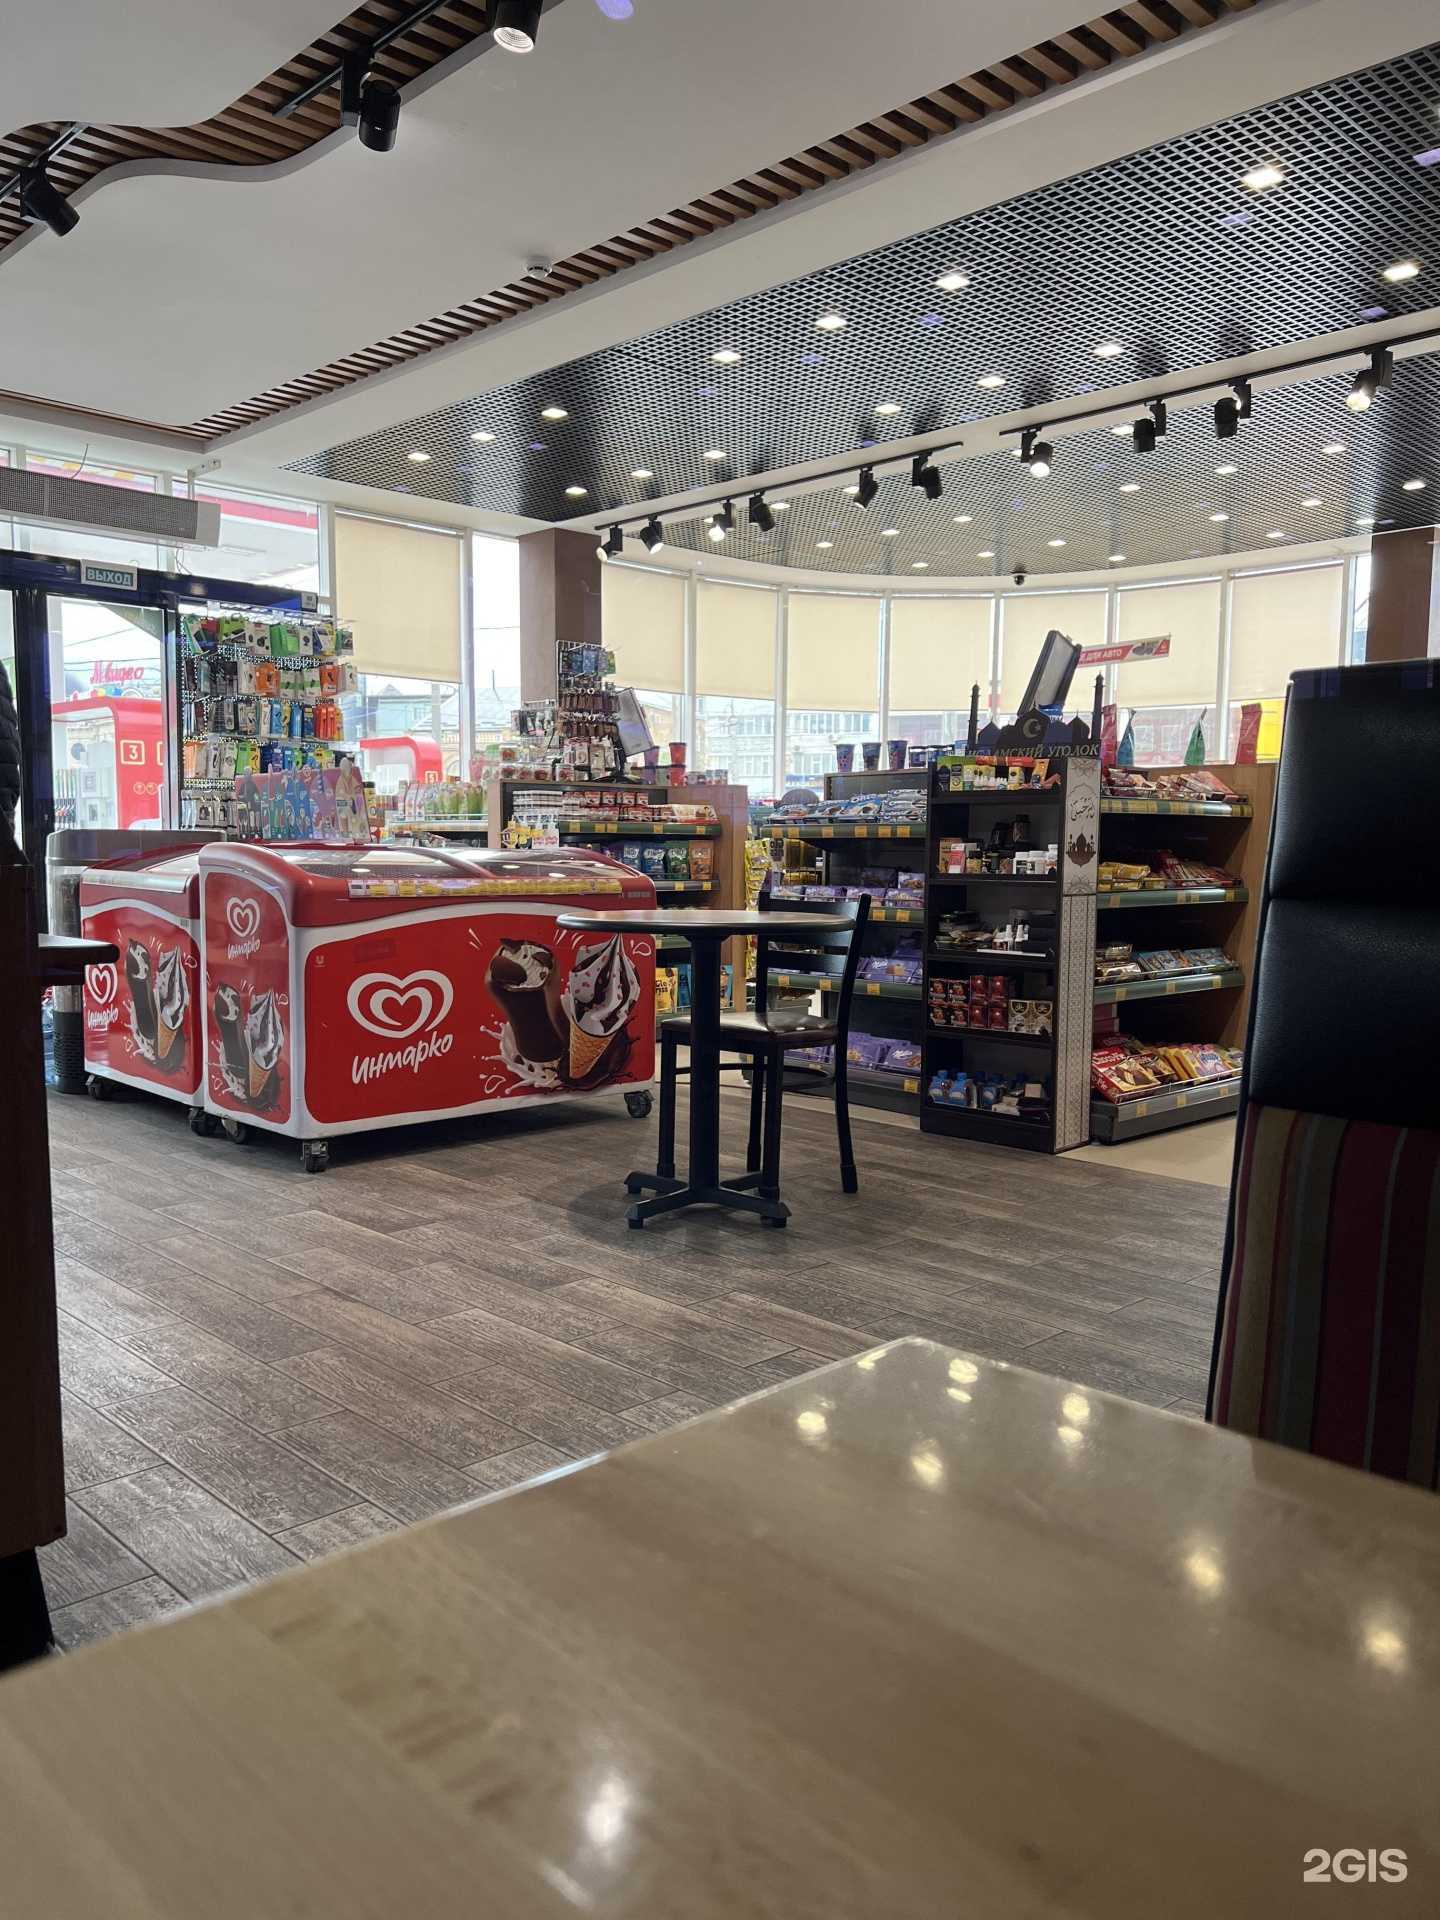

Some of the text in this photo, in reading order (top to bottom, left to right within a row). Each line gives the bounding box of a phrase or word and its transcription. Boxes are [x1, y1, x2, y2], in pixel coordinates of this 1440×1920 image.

[86, 568, 133, 587] ВЫХОД
[129, 744, 139, 760] 3
[1048, 743, 1099, 758] УГОЛОК
[227, 936, 261, 960] Инмарко
[351, 1031, 454, 1085] Инмарко
